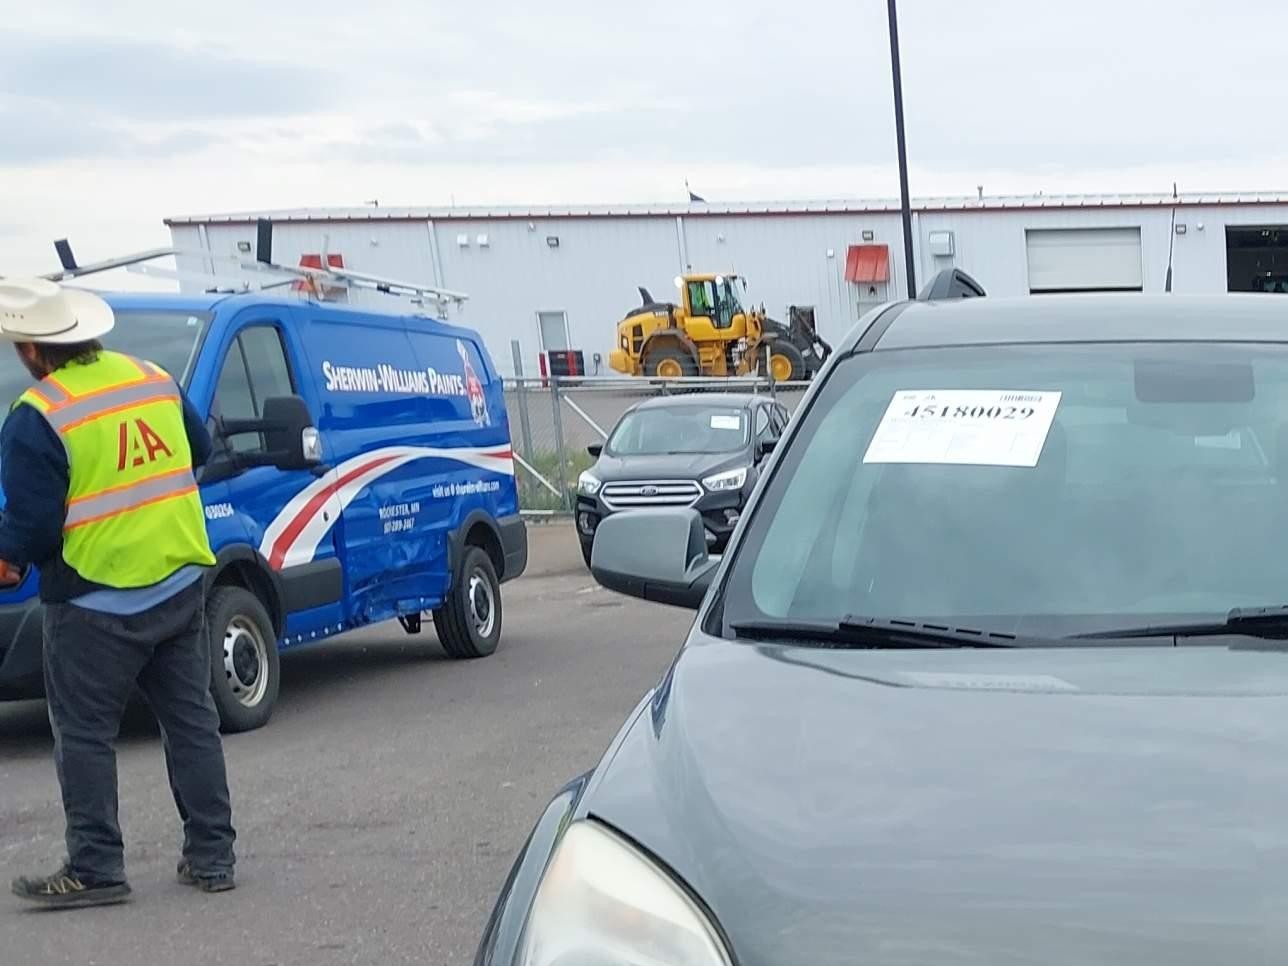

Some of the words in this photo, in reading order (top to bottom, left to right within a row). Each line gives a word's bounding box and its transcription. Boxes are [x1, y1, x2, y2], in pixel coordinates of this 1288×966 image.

[322, 361, 430, 394] SHERWIN-WILLIAMS
[427, 367, 465, 396] PAINTS
[904, 405, 1035, 420] 45180029
